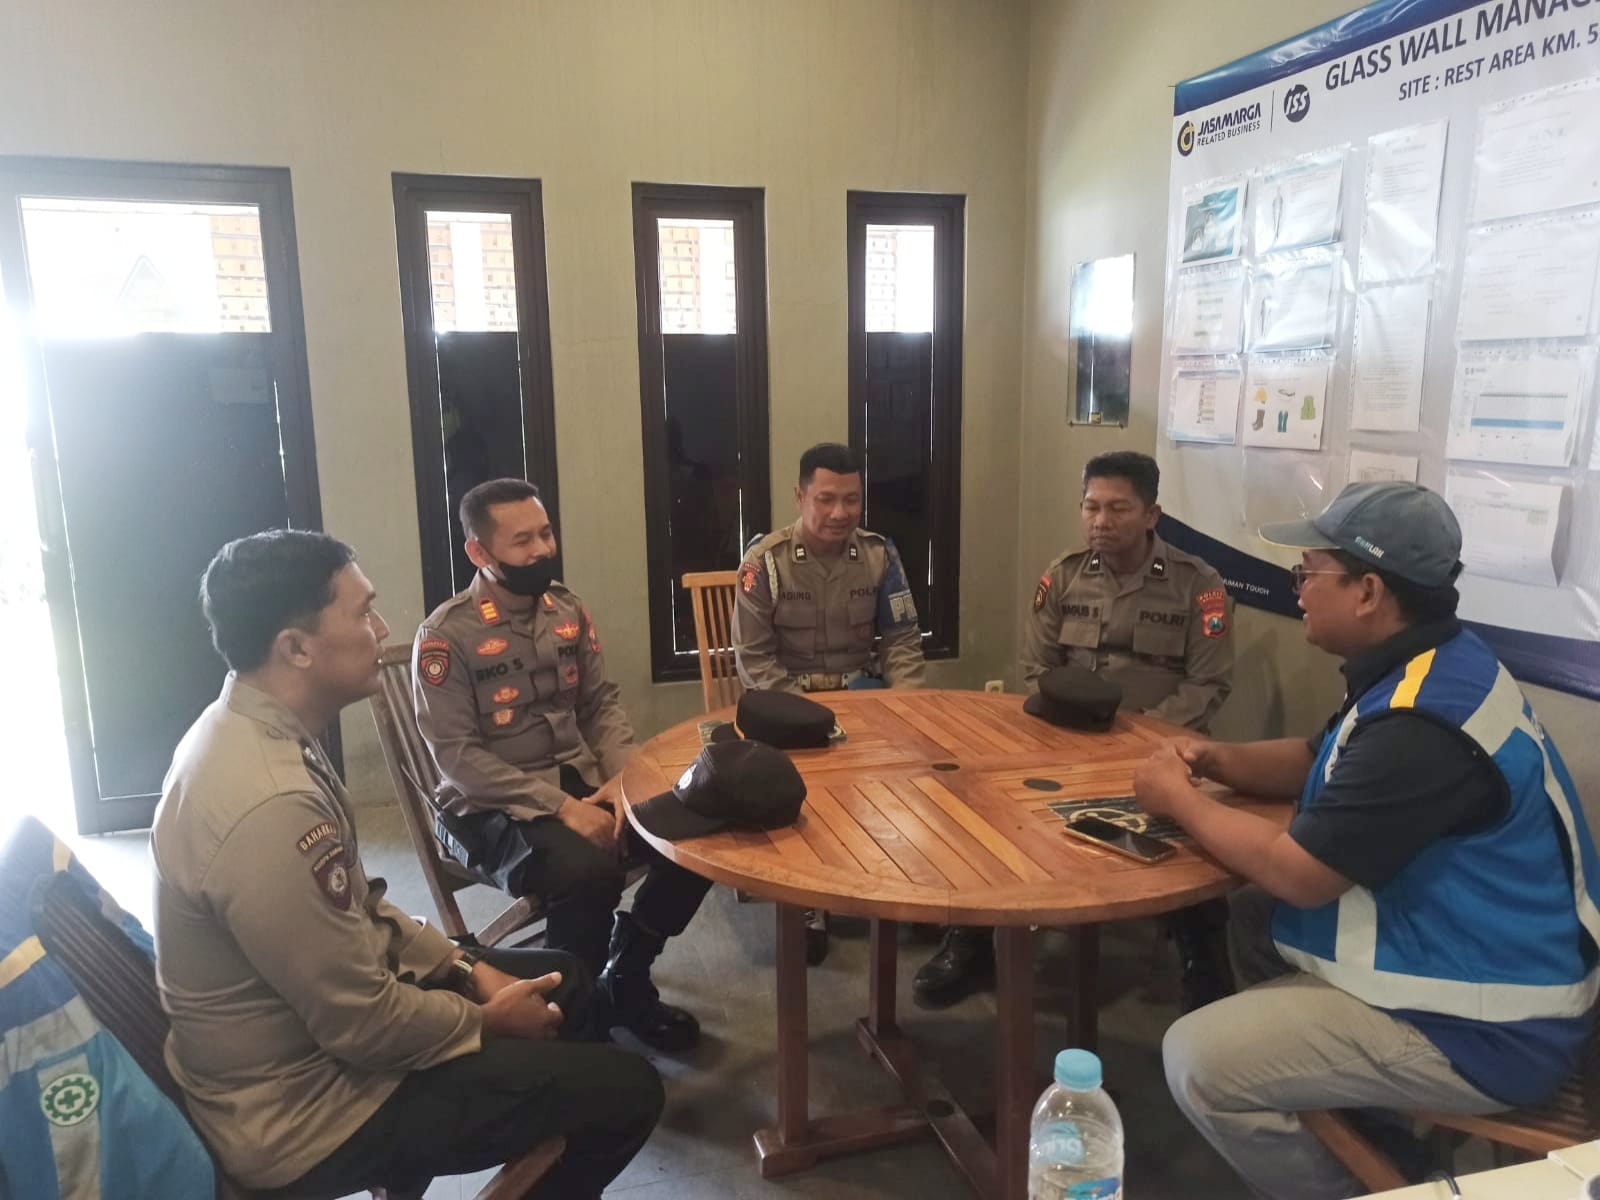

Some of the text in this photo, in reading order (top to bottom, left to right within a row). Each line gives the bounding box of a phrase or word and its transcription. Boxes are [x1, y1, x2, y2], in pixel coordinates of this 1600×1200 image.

[1325, 44, 1392, 91] GLASS
[1399, 18, 1467, 67] WALL
[1398, 74, 1431, 102] SITE
[1443, 57, 1486, 88] REST
[1488, 41, 1535, 75] AREA
[1541, 29, 1581, 58] KM.
[1586, 22, 1600, 45] 5
[1284, 86, 1310, 116] ISS
[1196, 119, 1261, 147] RELATED BUSINESS
[1197, 102, 1262, 137] JASAMARGA
[1139, 610, 1186, 627] POLRI
[512, 657, 524, 671] S
